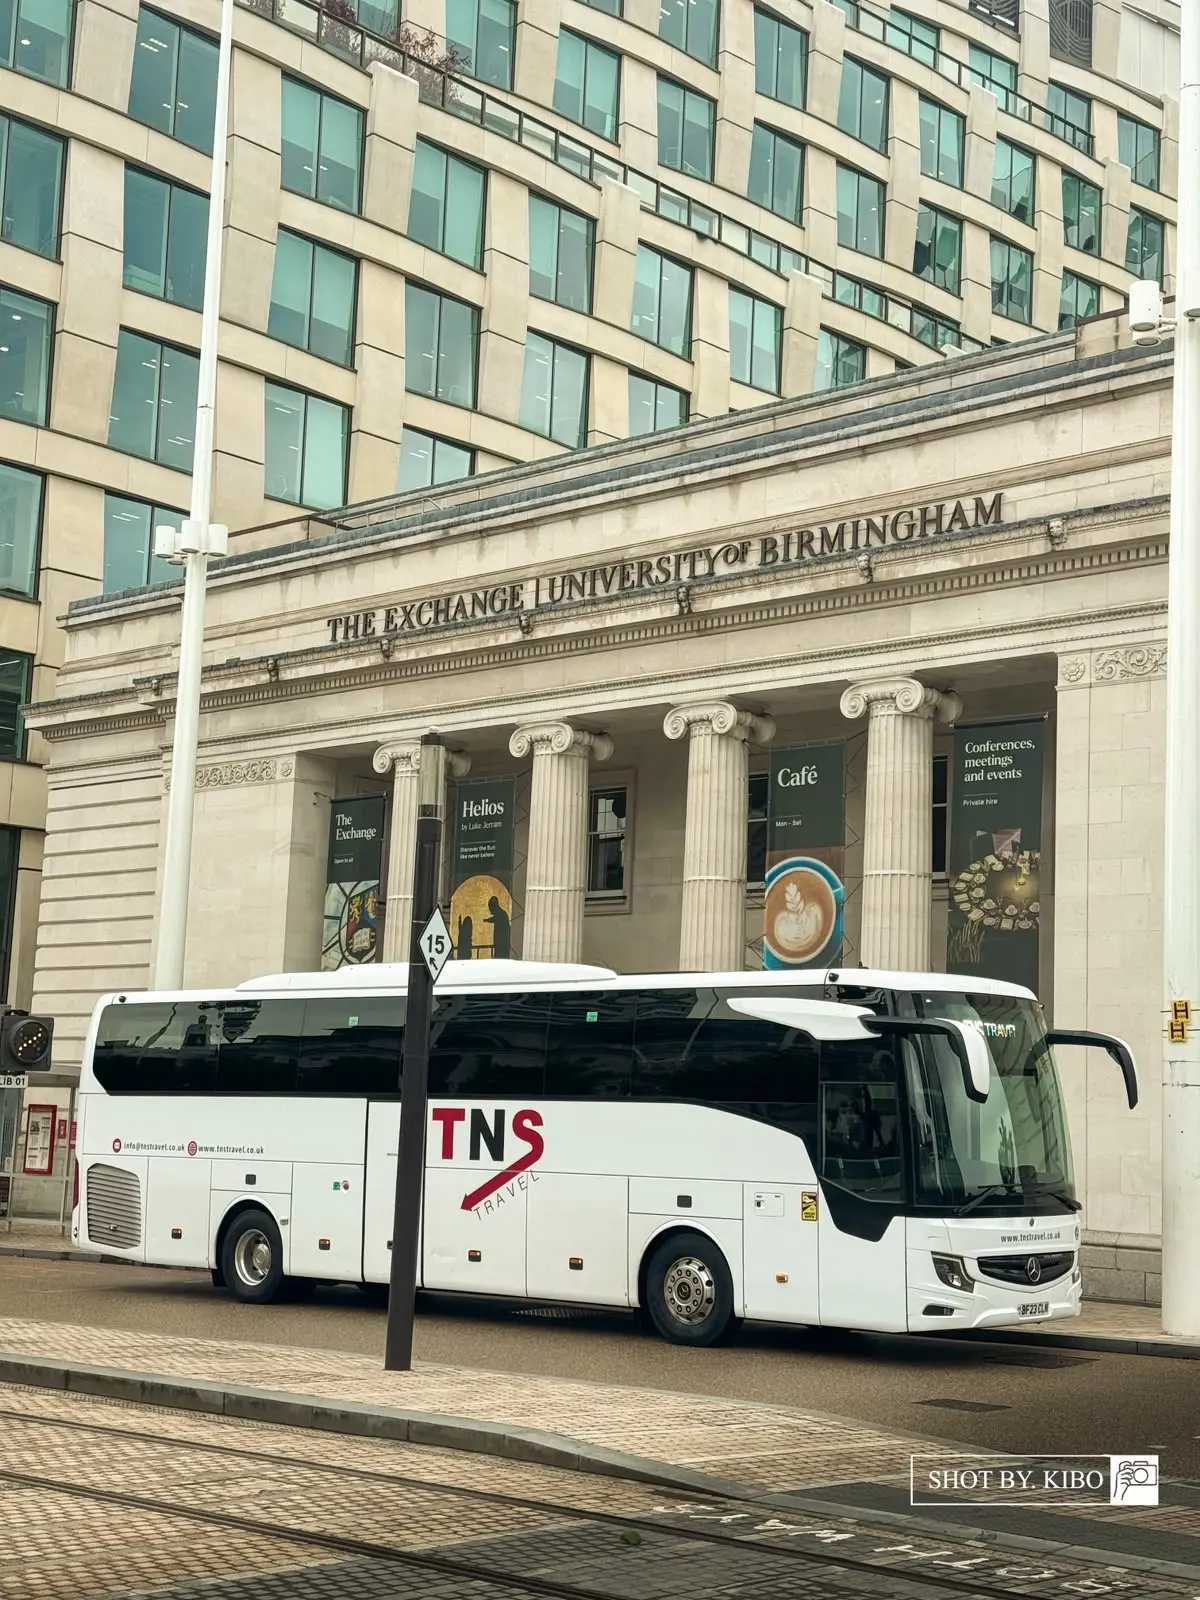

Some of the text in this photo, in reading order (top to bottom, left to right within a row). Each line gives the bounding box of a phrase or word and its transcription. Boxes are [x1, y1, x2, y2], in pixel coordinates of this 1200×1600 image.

[327, 612, 375, 642] THE
[383, 584, 524, 632] EXCHANGE
[548, 544, 734, 603] UNIVERSITY
[758, 492, 1004, 566] BIRMINGHAM
[965, 740, 1036, 754] Conferences,
[965, 754, 1013, 768] meetings
[778, 765, 818, 788] Café
[964, 768, 1022, 782] and events
[463, 798, 505, 818] Helios
[336, 814, 353, 826] The
[336, 827, 377, 841] Exchange
[427, 934, 445, 955] 15
[1174, 1002, 1189, 1020] H
[1170, 1021, 1185, 1039] H
[15, 1077, 25, 1086] 01
[432, 1107, 544, 1166] TNS
[124, 1141, 185, 1152] info@tnstravel.co.uk
[199, 1144, 265, 1155] www.tnstravel.co.uk
[473, 1169, 540, 1221] TRAVEL
[1001, 1231, 1060, 1243] www.tnstravel.co.uk
